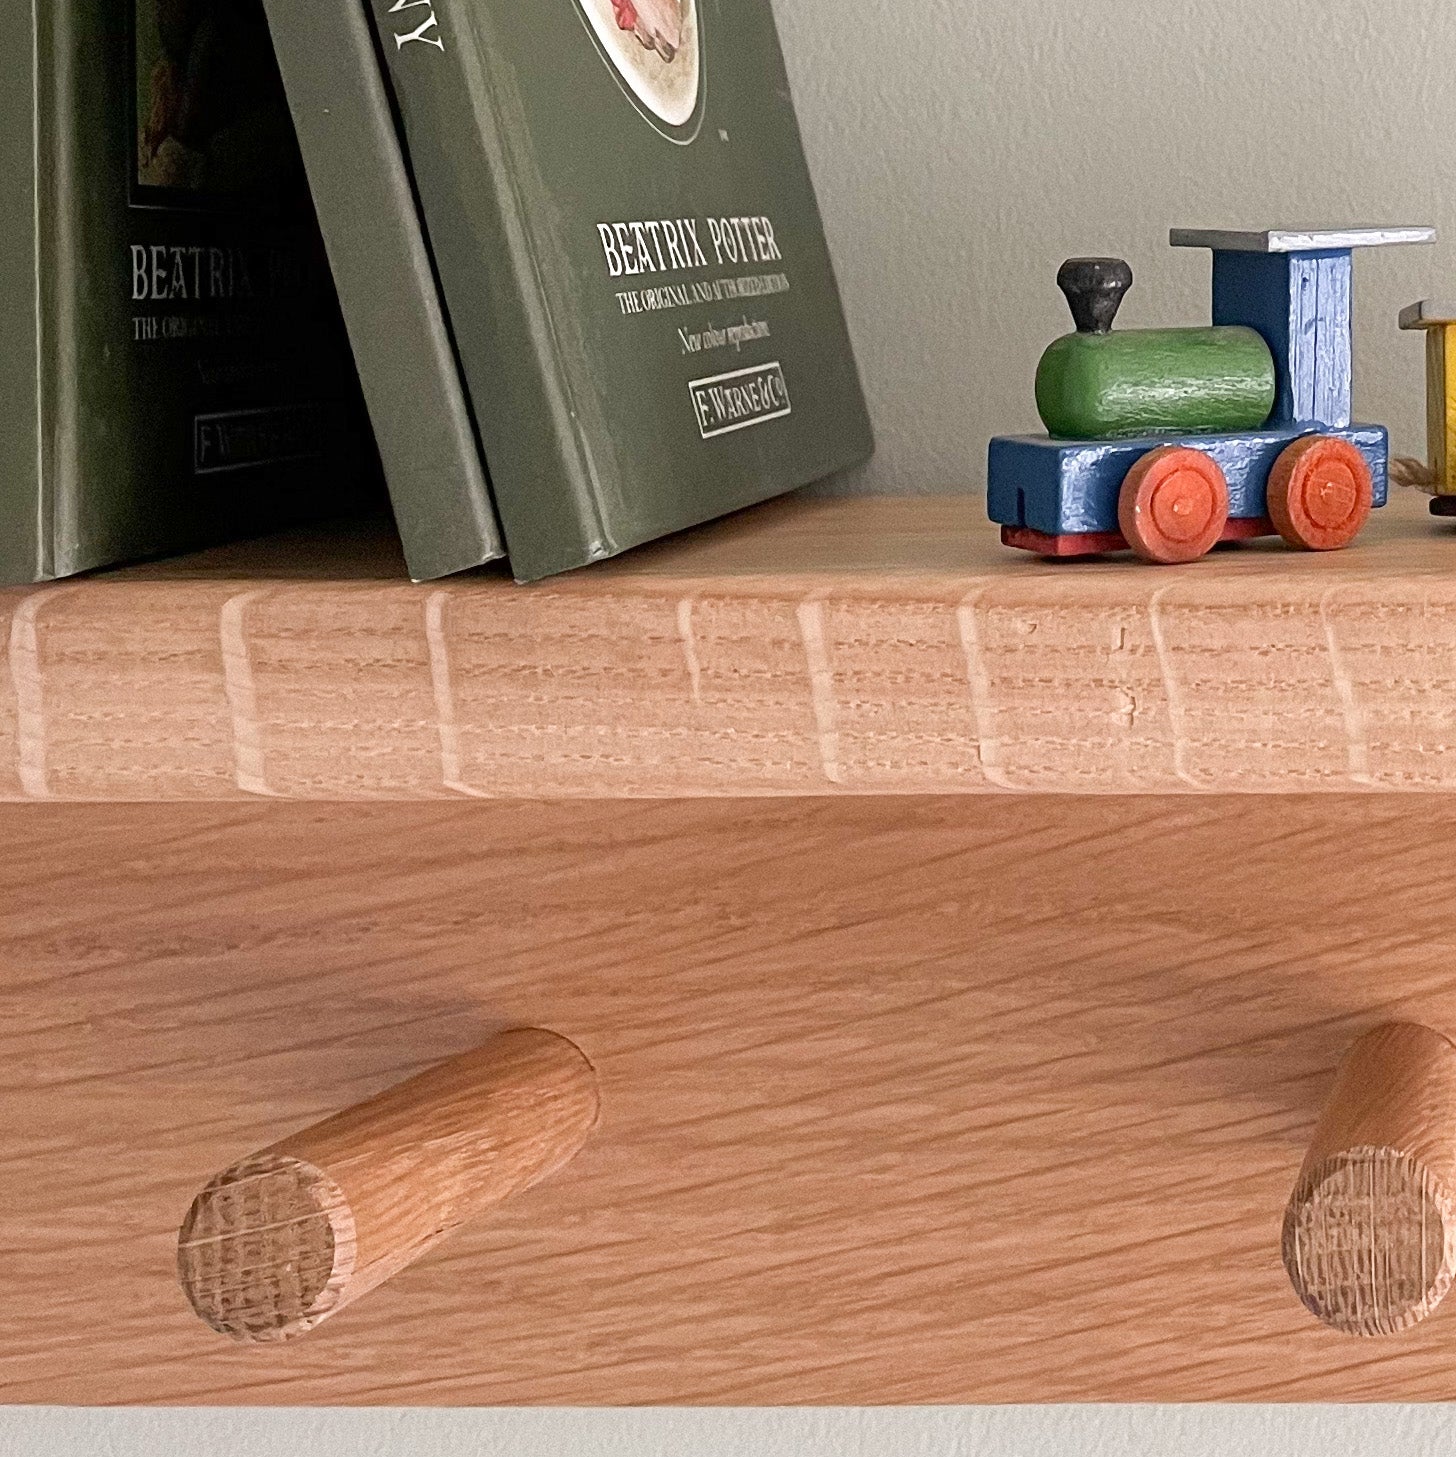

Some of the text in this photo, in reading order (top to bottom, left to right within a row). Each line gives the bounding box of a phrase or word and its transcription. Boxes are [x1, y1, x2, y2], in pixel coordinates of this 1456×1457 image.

[596, 216, 782, 277] BEATRIX POTTER
[615, 291, 644, 314] THE
[641, 283, 693, 311] ORIGINAL
